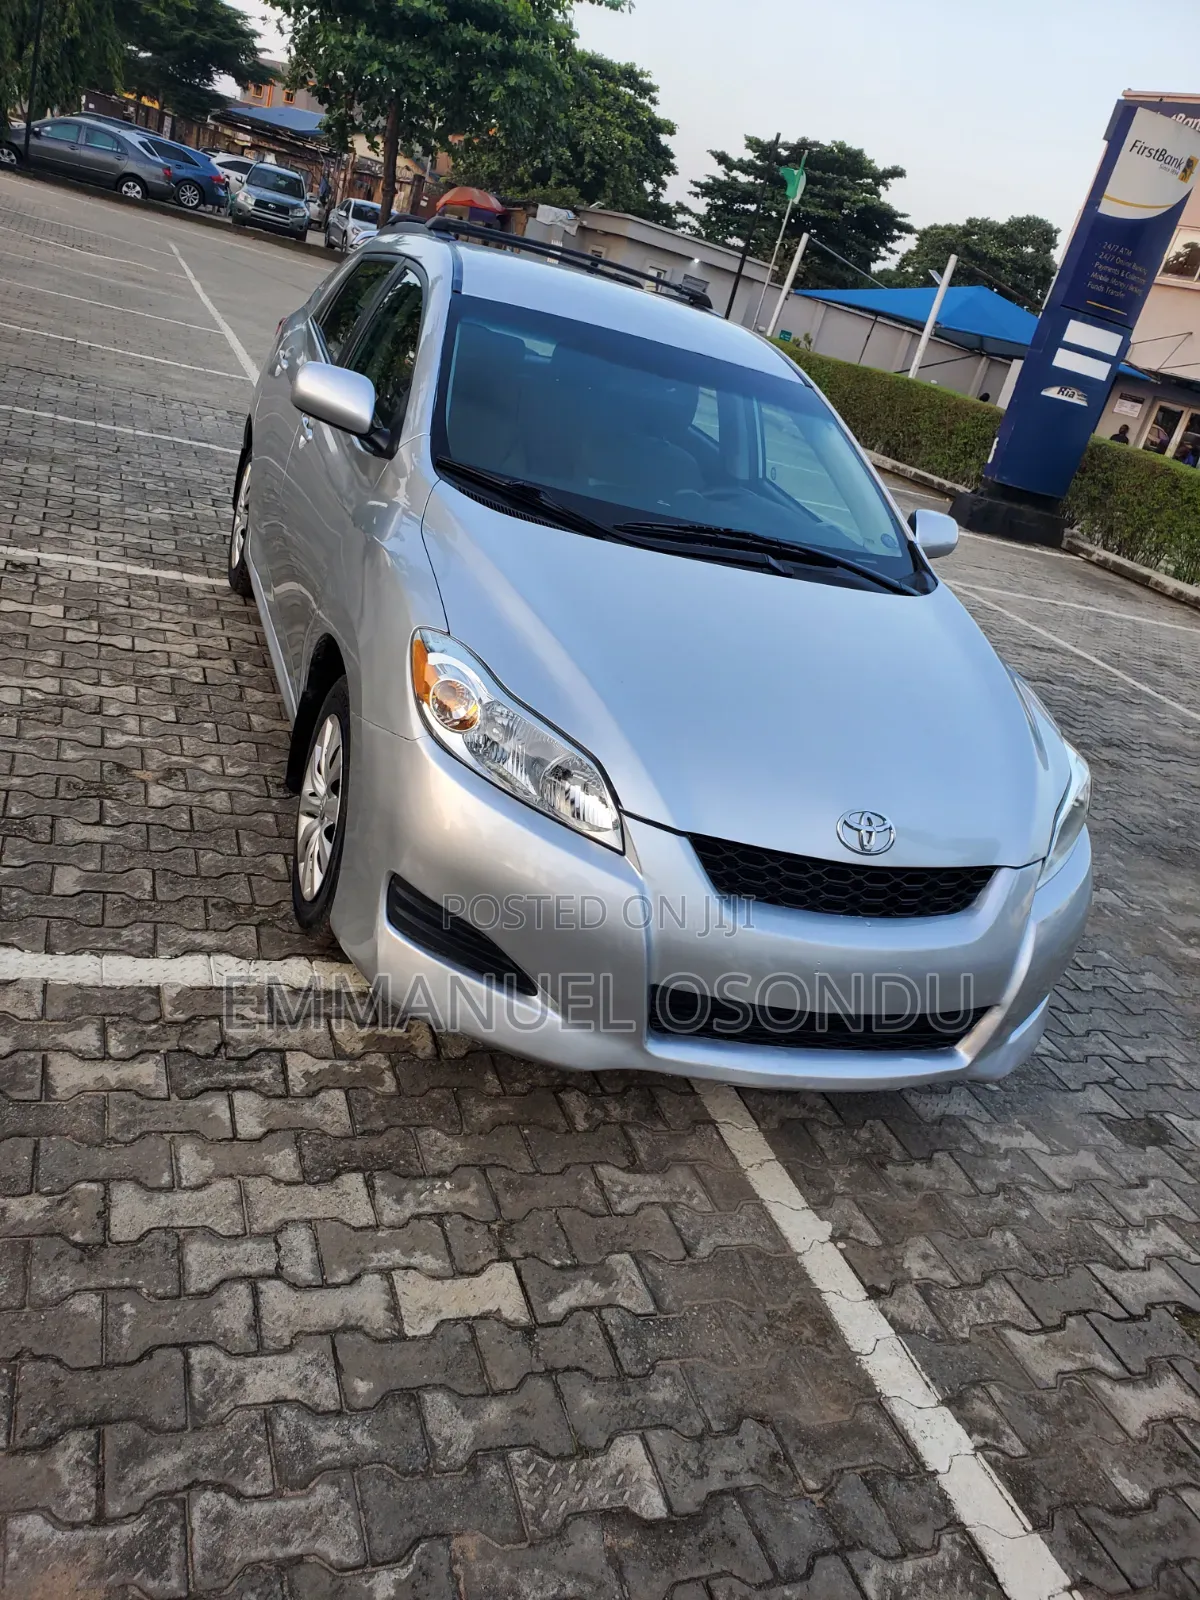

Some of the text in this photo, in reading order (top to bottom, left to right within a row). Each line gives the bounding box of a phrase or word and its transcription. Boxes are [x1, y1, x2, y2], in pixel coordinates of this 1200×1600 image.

[1129, 139, 1185, 171] FirstBank
[1103, 241, 1133, 257] 24/7 ATM
[1099, 251, 1115, 262] 24/7
[1094, 261, 1120, 275] Payments
[1090, 271, 1110, 283] Mobile
[1087, 280, 1126, 299] Funds Transfer
[1057, 386, 1076, 399] Ria
